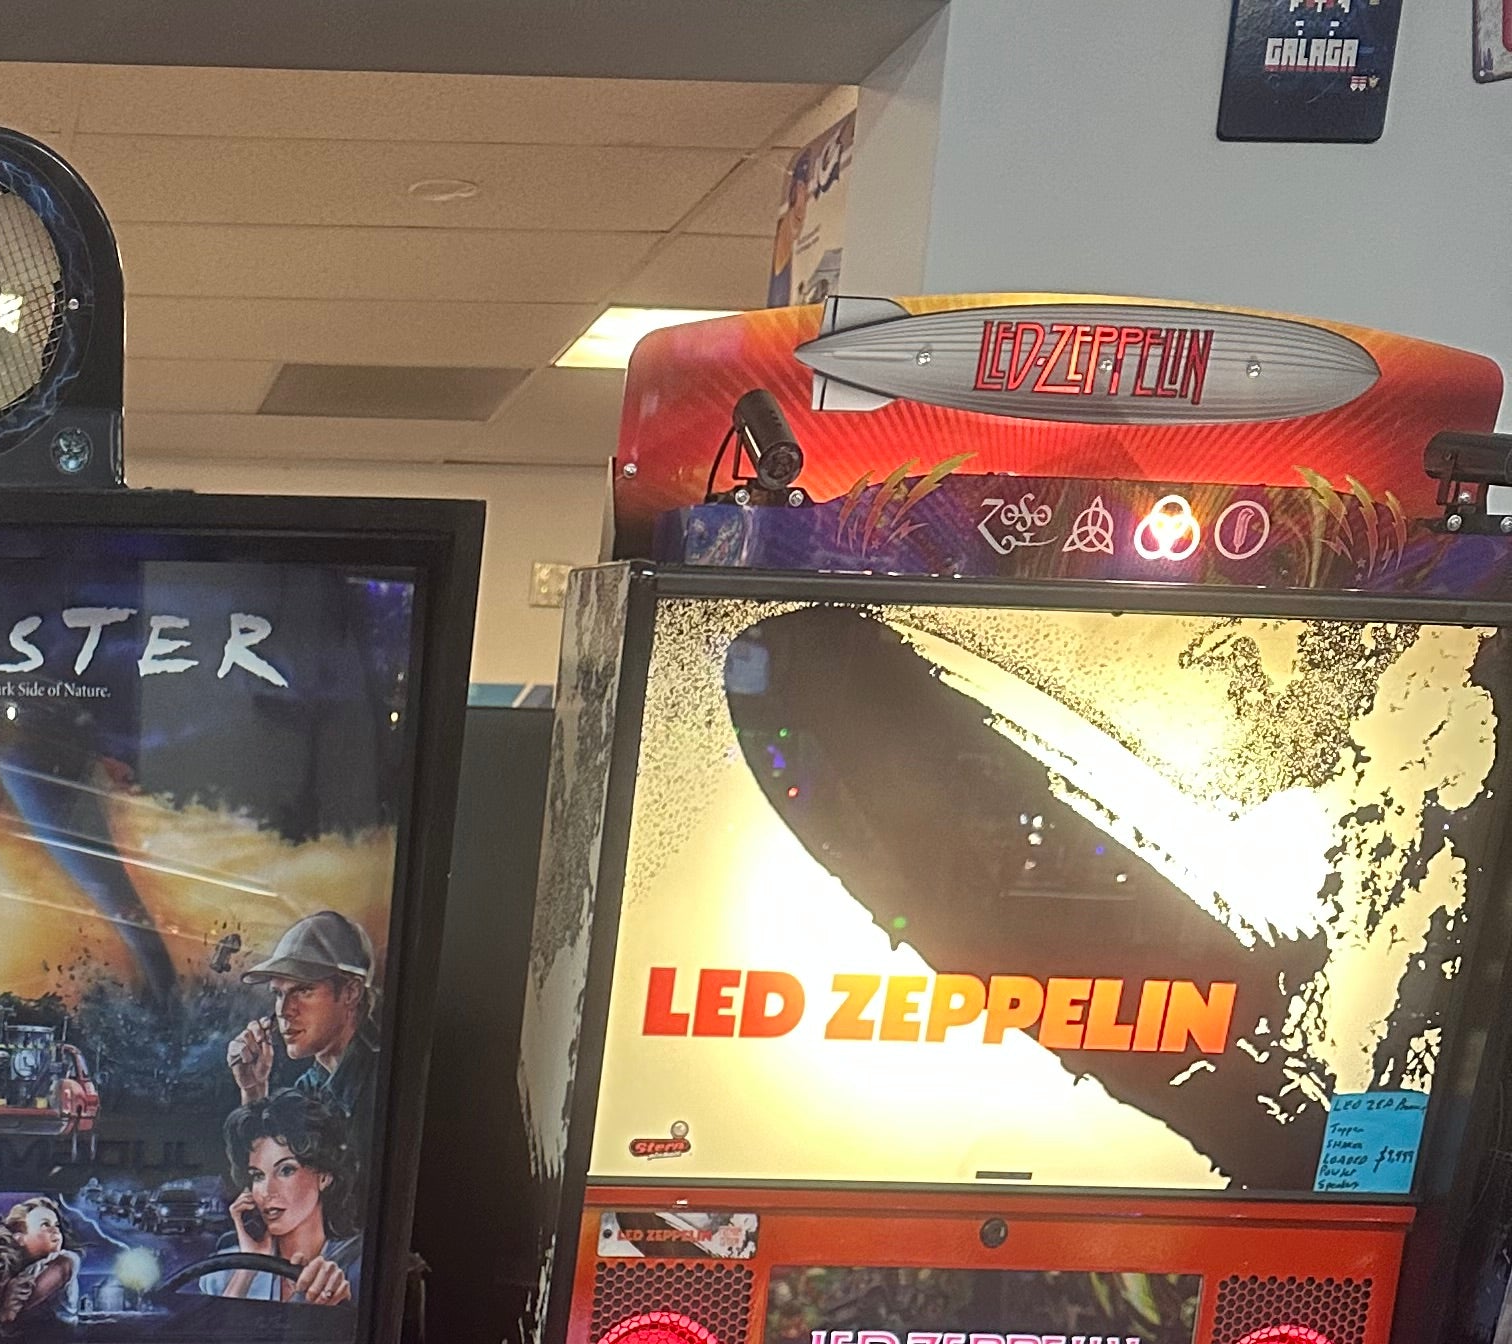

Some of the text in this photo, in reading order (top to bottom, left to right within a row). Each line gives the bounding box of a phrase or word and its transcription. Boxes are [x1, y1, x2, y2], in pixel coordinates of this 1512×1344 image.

[1264, 38, 1359, 67] GALAGA
[18, 682, 43, 697] Side
[46, 682, 62, 698] of
[64, 682, 111, 698] Nature.
[642, 967, 1237, 1054] LED ZEPPELIN
[633, 1139, 688, 1155] Stern
